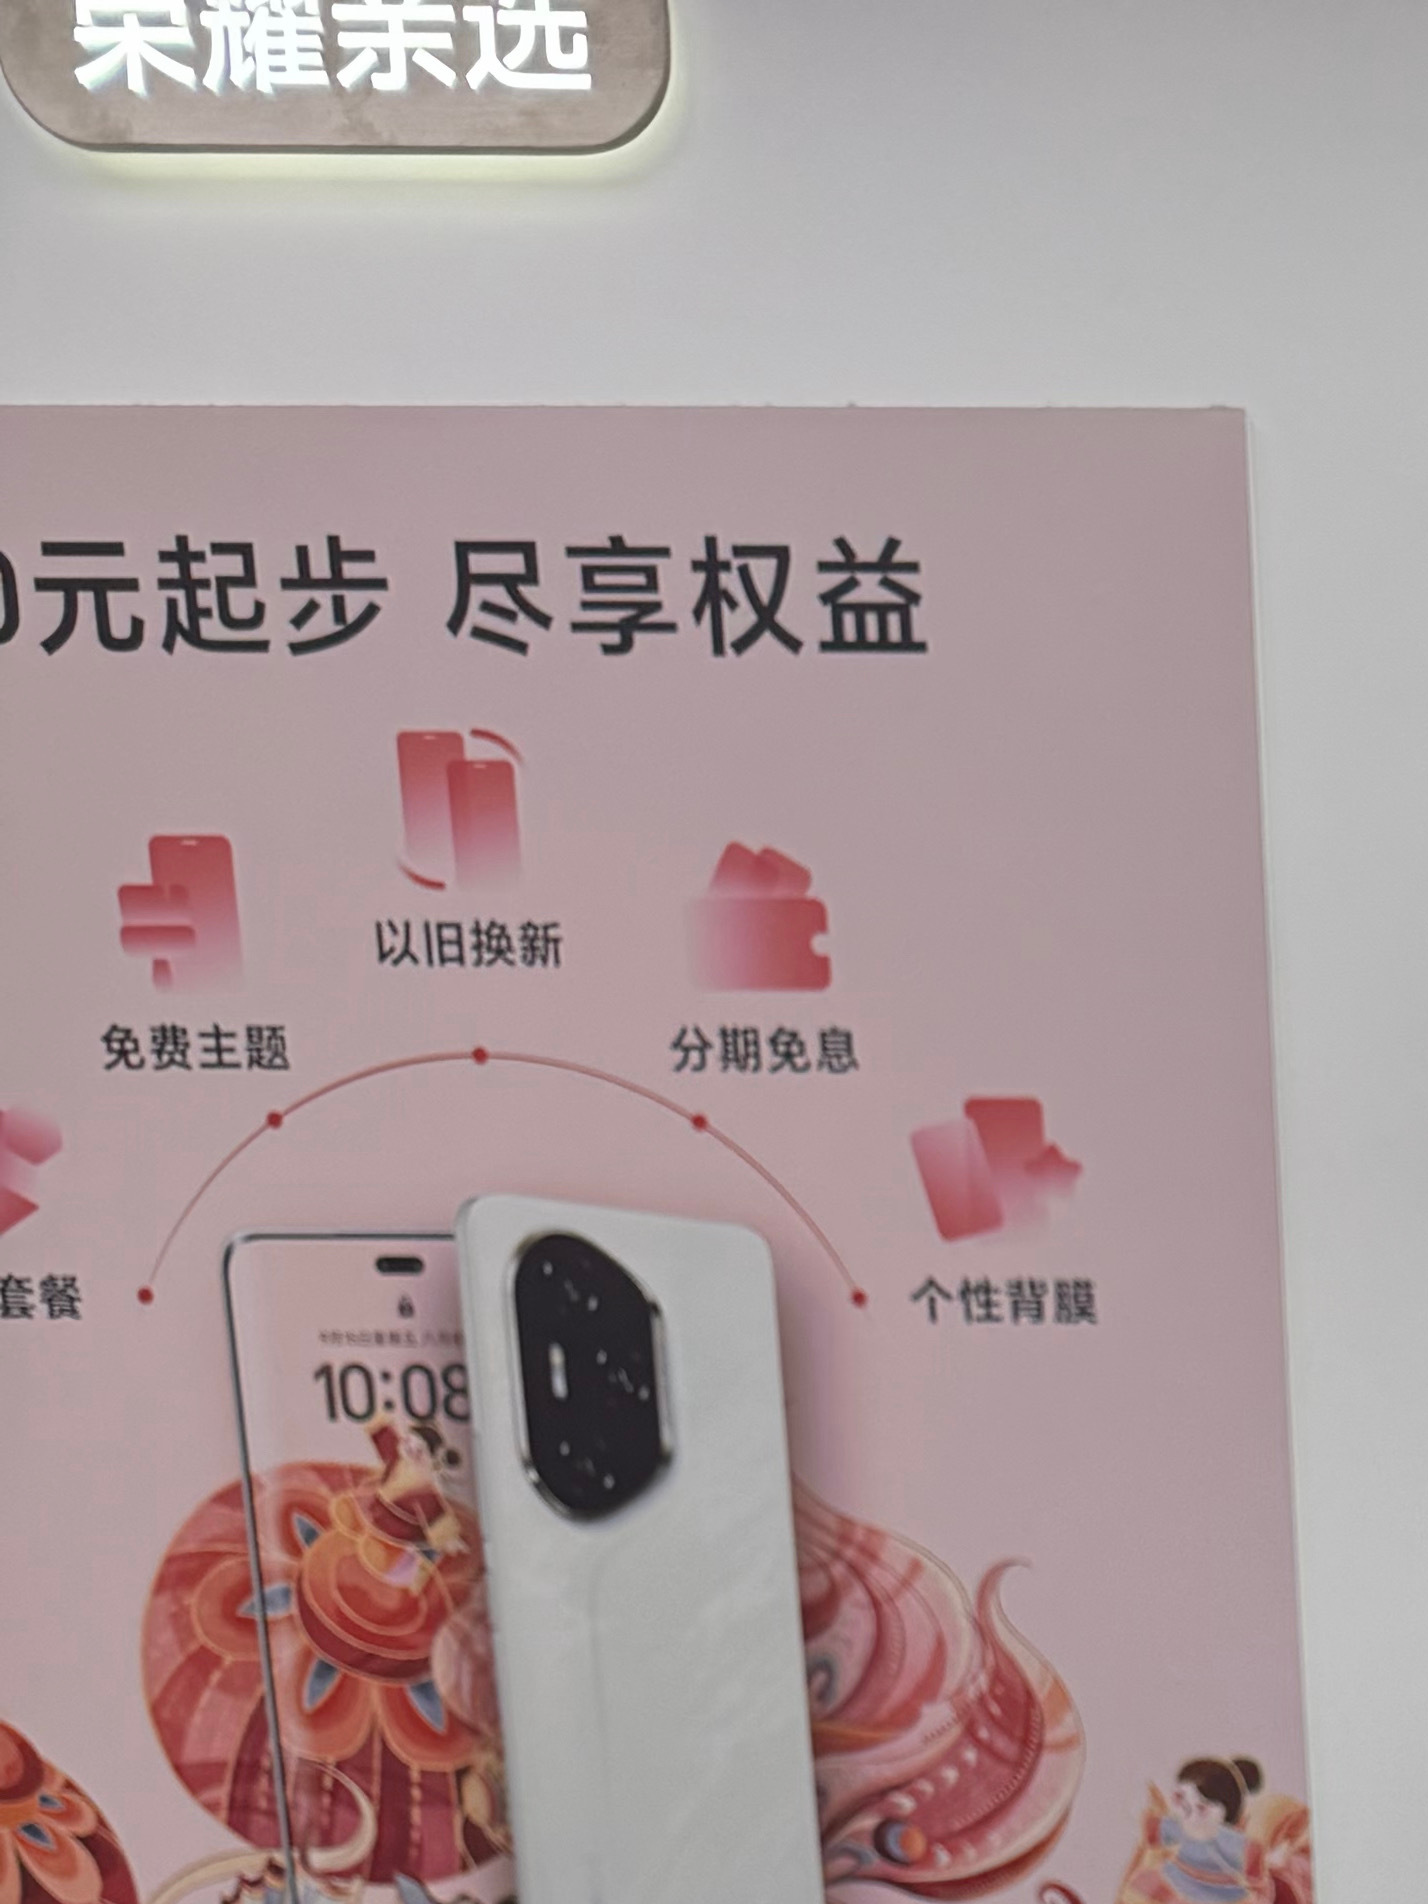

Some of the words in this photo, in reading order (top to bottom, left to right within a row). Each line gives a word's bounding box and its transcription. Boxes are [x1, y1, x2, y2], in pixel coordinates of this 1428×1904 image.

[444, 535, 928, 657] 尽享权益
[374, 918, 564, 970] 以旧换新
[100, 1024, 291, 1073] 免费主题
[669, 1025, 861, 1074] 分期免息
[0, 1273, 82, 1320] 套餐
[909, 1278, 1099, 1327] 个性背膜
[313, 1362, 471, 1423] 10:08
